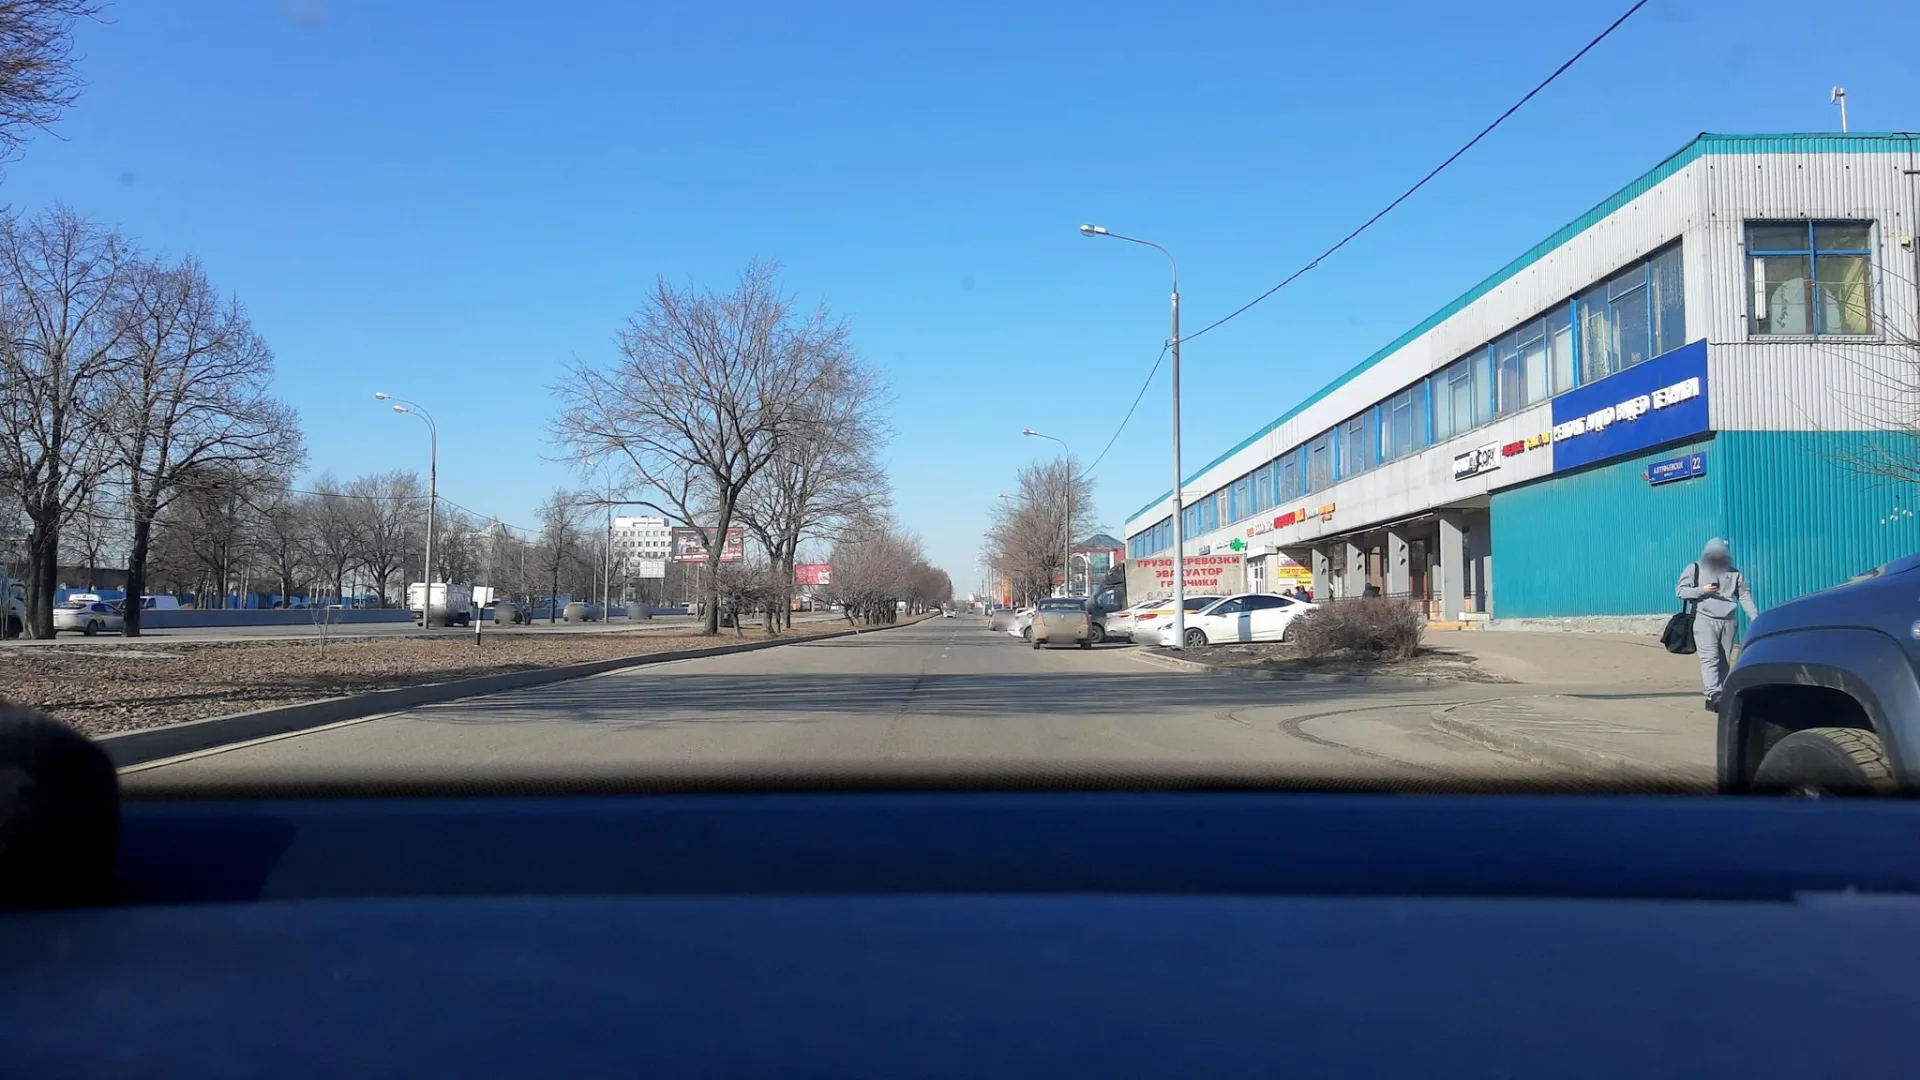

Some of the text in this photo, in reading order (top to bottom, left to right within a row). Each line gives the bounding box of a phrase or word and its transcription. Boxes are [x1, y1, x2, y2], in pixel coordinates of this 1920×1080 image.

[1692, 457, 1701, 470] 22
[1136, 556, 1240, 568] ГРУЗОЕРЕВОЗКИ
[1155, 568, 1223, 578] ЭВАУАТОР
[1160, 579, 1217, 588] ГРЗЧИКИ
